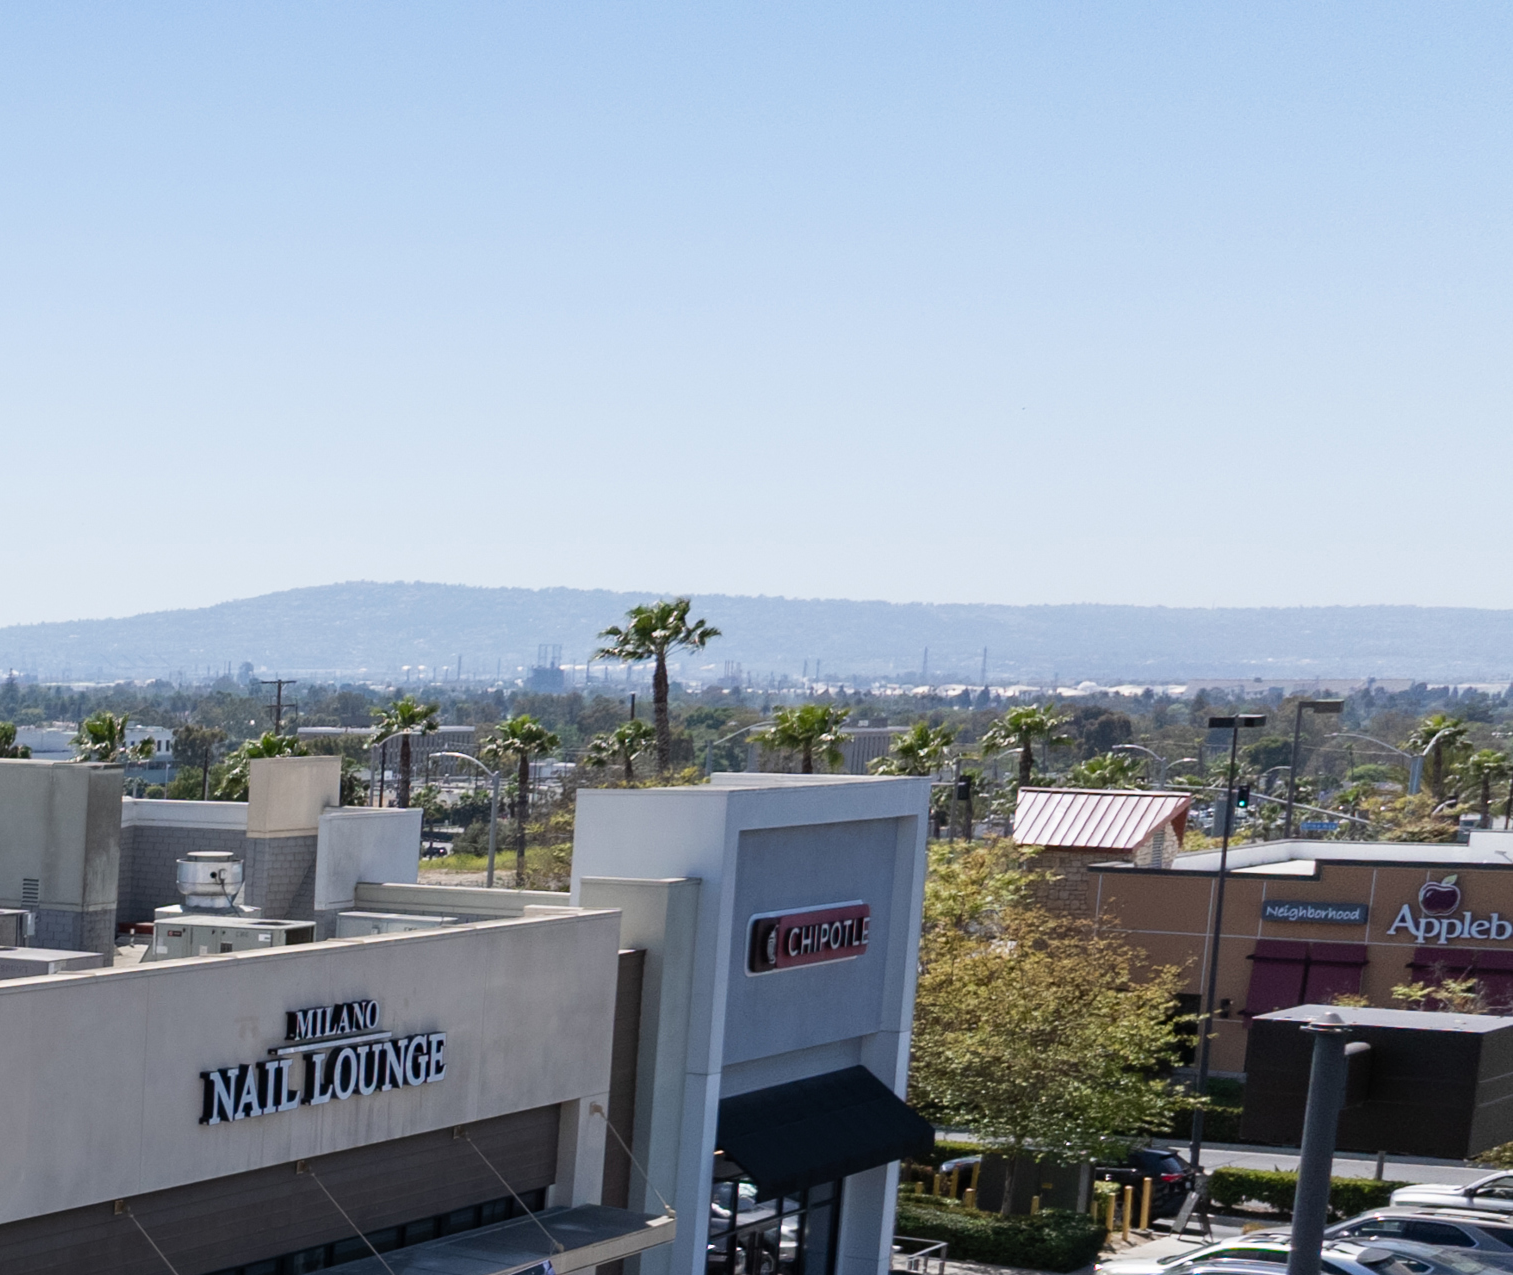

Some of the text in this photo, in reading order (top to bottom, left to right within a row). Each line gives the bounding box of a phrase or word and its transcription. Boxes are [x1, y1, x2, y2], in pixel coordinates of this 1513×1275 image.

[1265, 905, 1360, 921] Neighborhood
[1386, 904, 1513, 944] Appleb
[788, 917, 870, 957] CHIPOTLE
[292, 1000, 380, 1041] MILANO
[206, 1031, 448, 1126] NAIL LOUNGE
